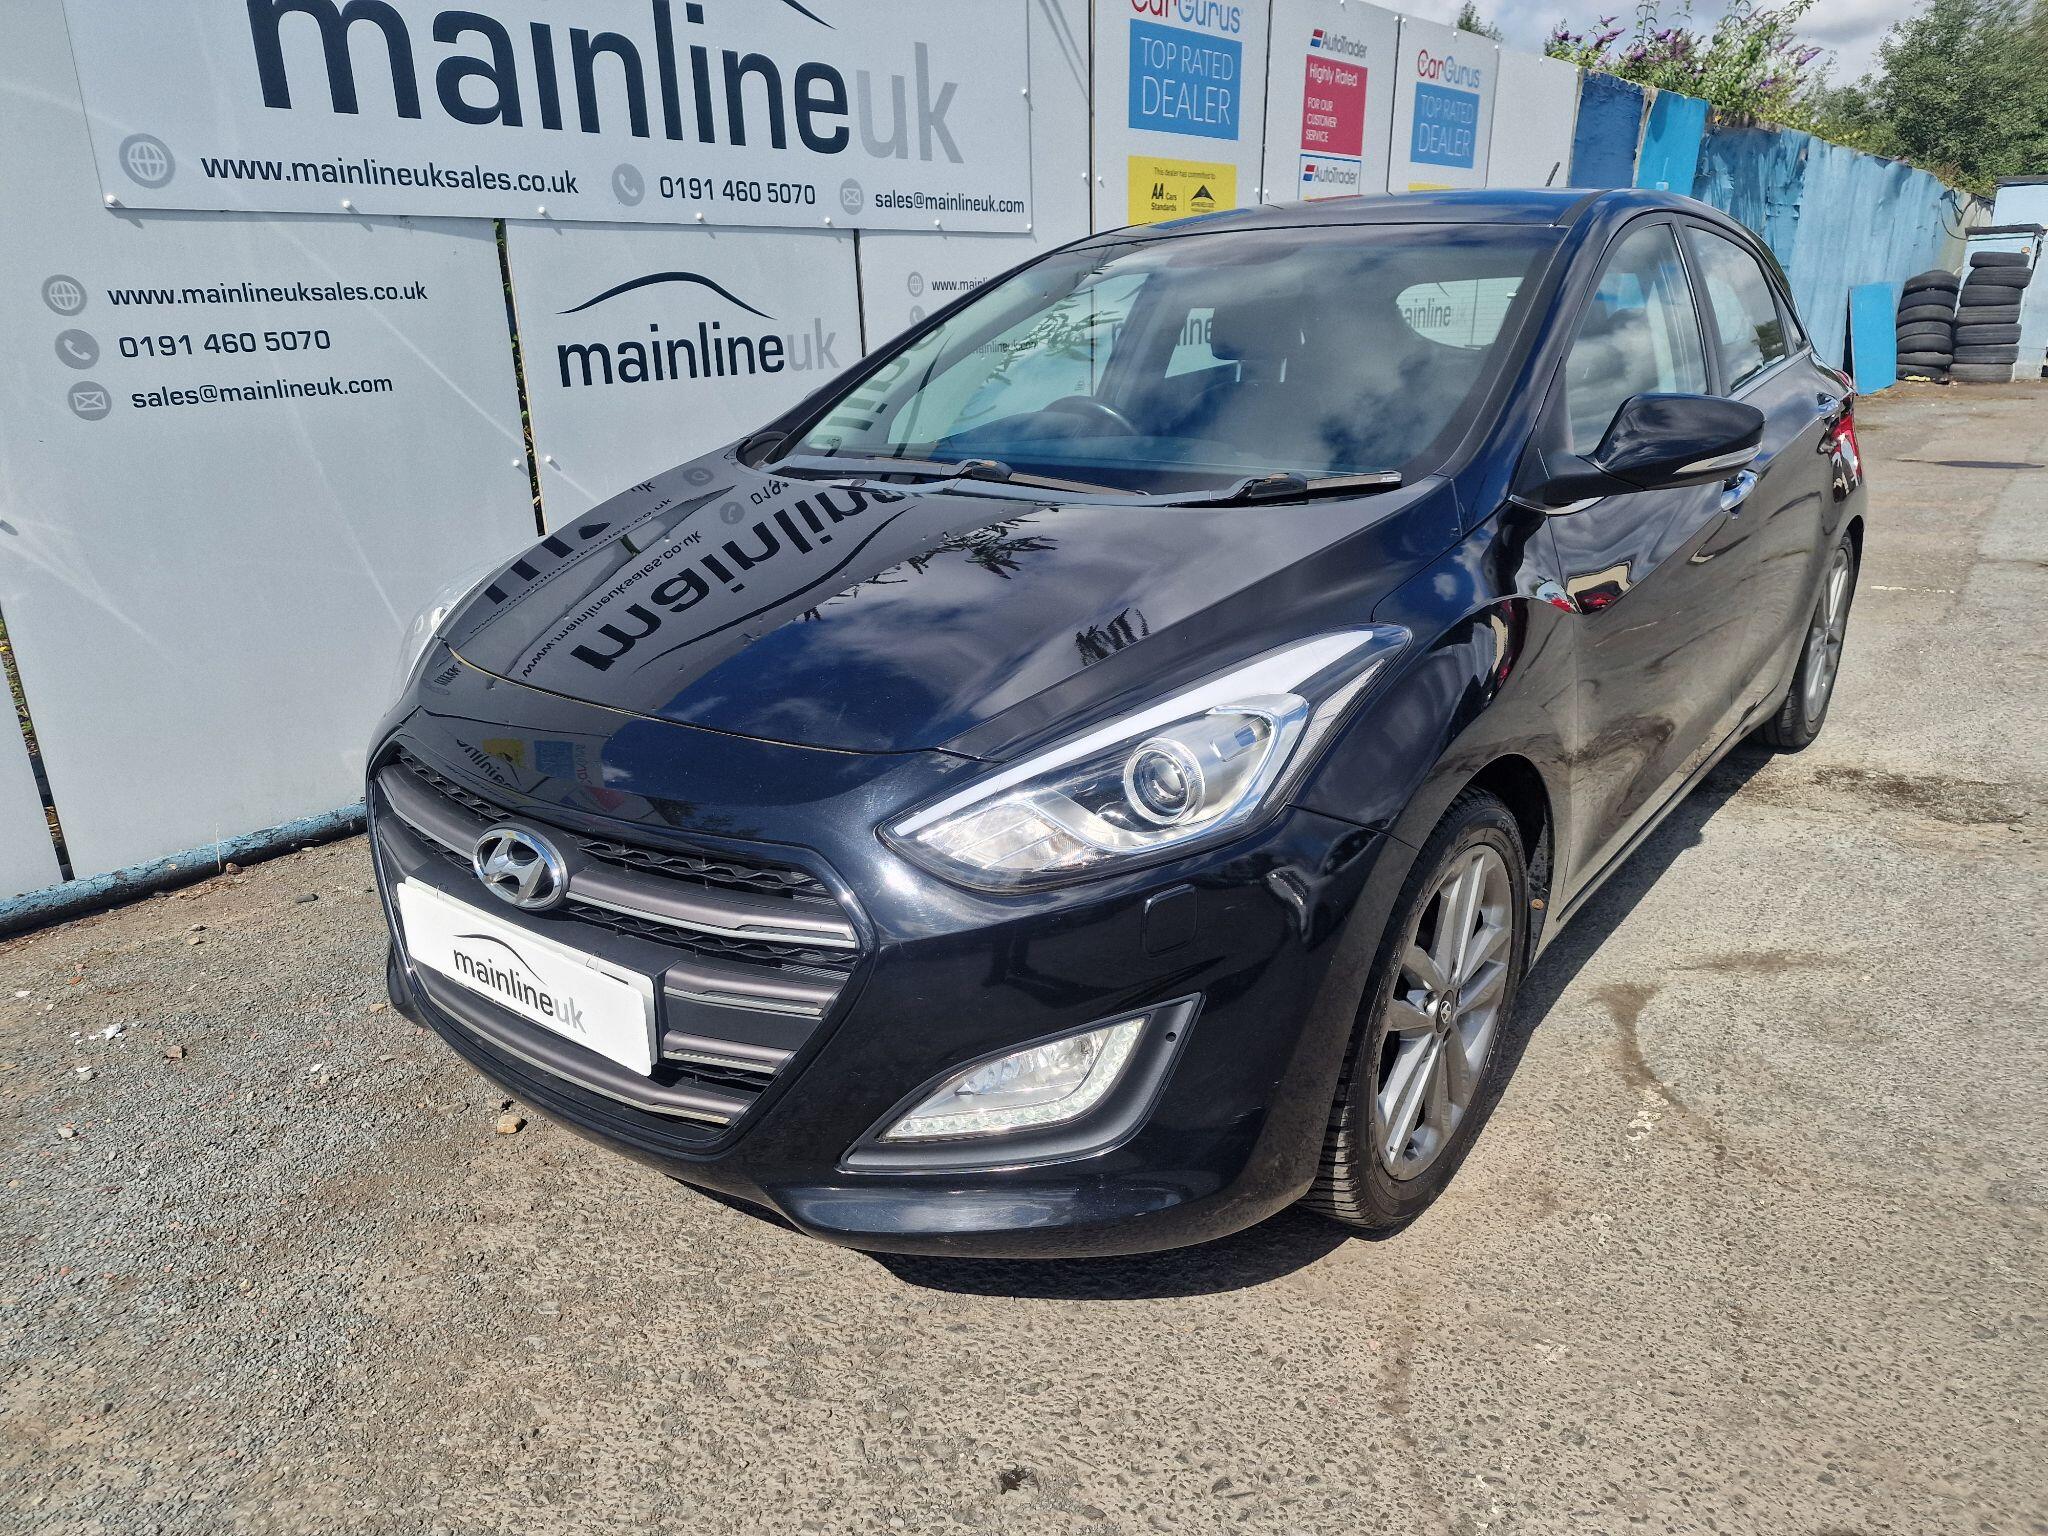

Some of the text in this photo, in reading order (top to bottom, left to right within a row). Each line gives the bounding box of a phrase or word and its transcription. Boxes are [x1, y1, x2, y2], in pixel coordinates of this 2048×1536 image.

[1140, 37, 1234, 81] TOP RATED
[1321, 31, 1368, 59] AutoTrader
[246, 0, 965, 164] mainlineuk
[1309, 63, 1359, 87] Highly Rated
[1417, 49, 1481, 88] CarGurus
[1142, 75, 1231, 125] DEALER
[1420, 94, 1474, 124] TOP RATED
[1418, 122, 1472, 157] DEALER
[200, 156, 579, 194] www.mainlineuksales.co.uk
[660, 175, 816, 205] 0191 460 5070
[1314, 165, 1358, 185] AutoTrader
[875, 190, 1025, 214] sales@mainlineuk.com
[1151, 182, 1177, 201] AA Cars
[1150, 202, 1177, 212] Standards
[107, 280, 429, 306] www.mainlineuksales.co.uk
[118, 329, 331, 359] 0191 460 5070
[557, 317, 840, 389] mainlineuk
[132, 376, 394, 409] sales@mainlineuk.com
[453, 949, 587, 1034] mainlineuk
